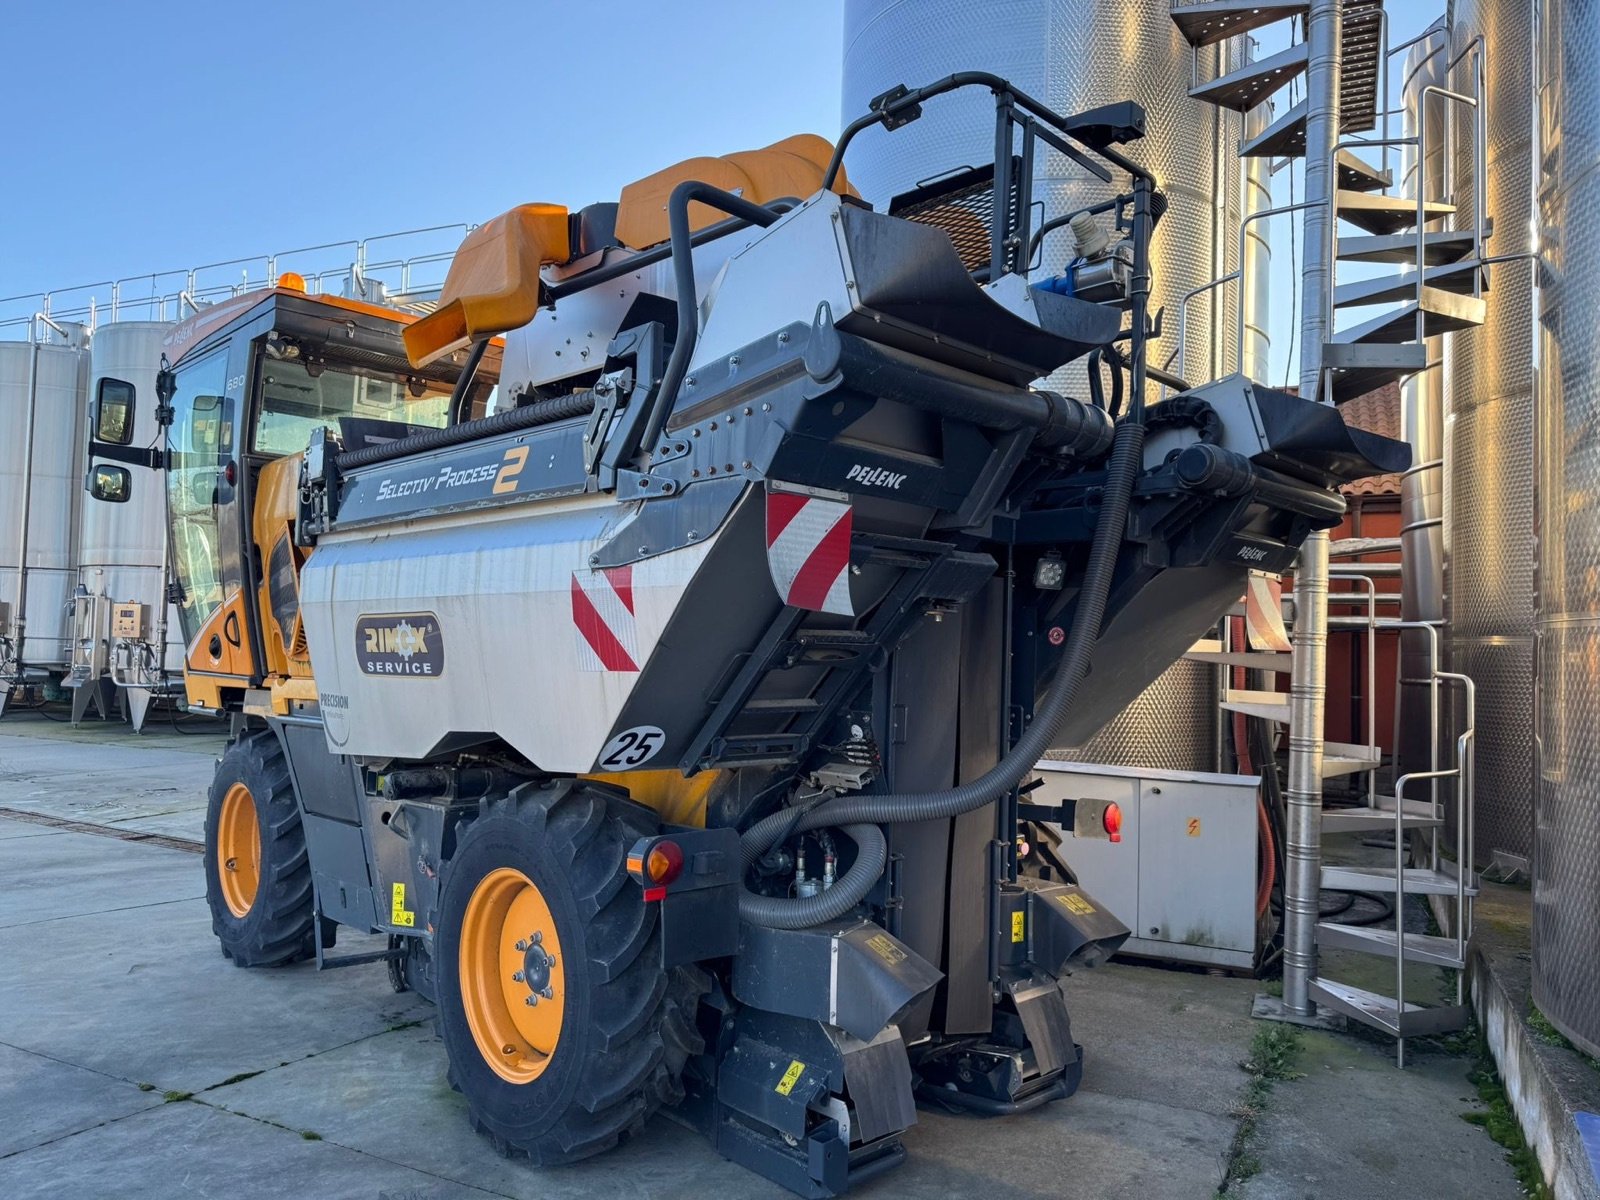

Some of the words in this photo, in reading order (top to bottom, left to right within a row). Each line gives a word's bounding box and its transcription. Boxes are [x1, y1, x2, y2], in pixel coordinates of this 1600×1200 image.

[227, 375, 245, 391] 680
[492, 446, 530, 494] 2
[845, 464, 908, 489] PELLENC
[367, 661, 432, 674] SERVICE
[320, 693, 349, 709] PRECISION
[602, 732, 662, 765] 25
